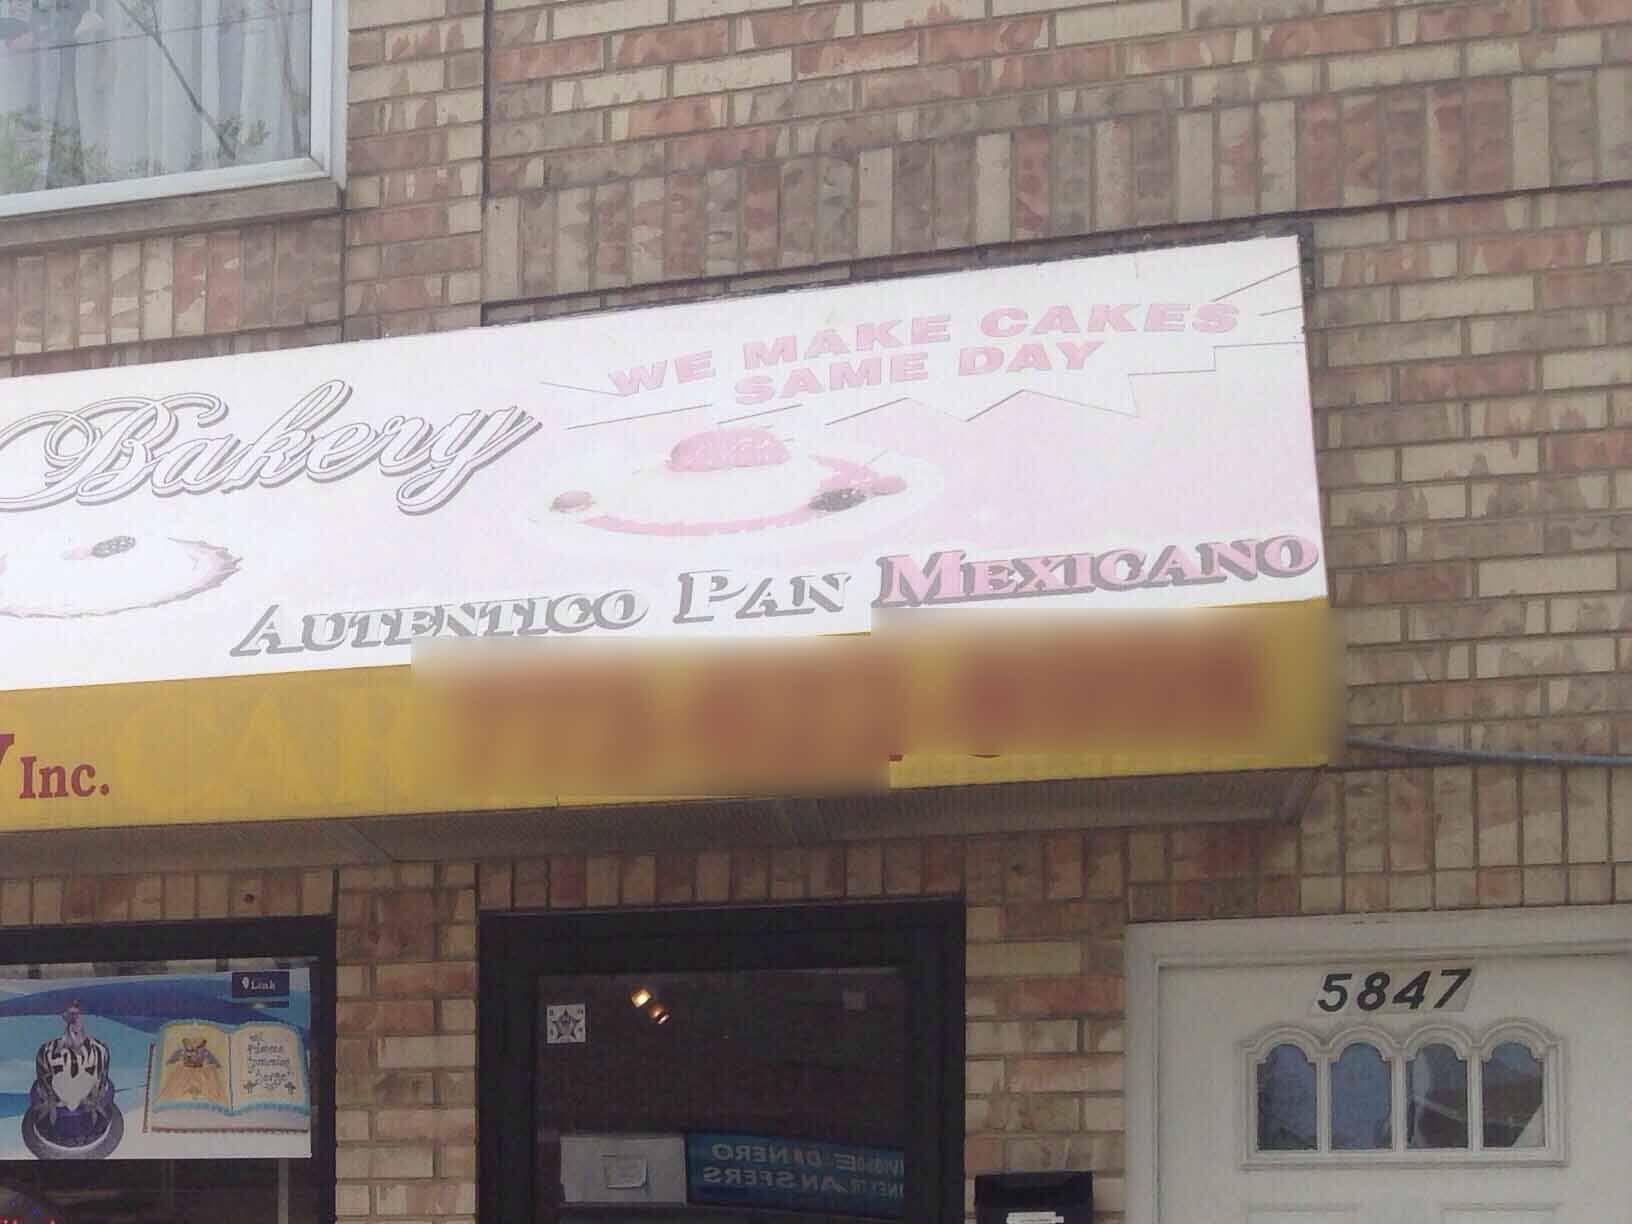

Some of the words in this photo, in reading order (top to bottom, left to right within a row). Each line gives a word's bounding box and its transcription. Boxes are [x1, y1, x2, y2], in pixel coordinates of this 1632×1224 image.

[608, 350, 716, 398] WE
[744, 314, 952, 371] MAKE
[979, 302, 1239, 336] CAKES
[735, 350, 930, 405] SAME
[958, 340, 1103, 377] DAY
[19, 754, 110, 800] Inc.
[1317, 967, 1472, 1013] 5847
